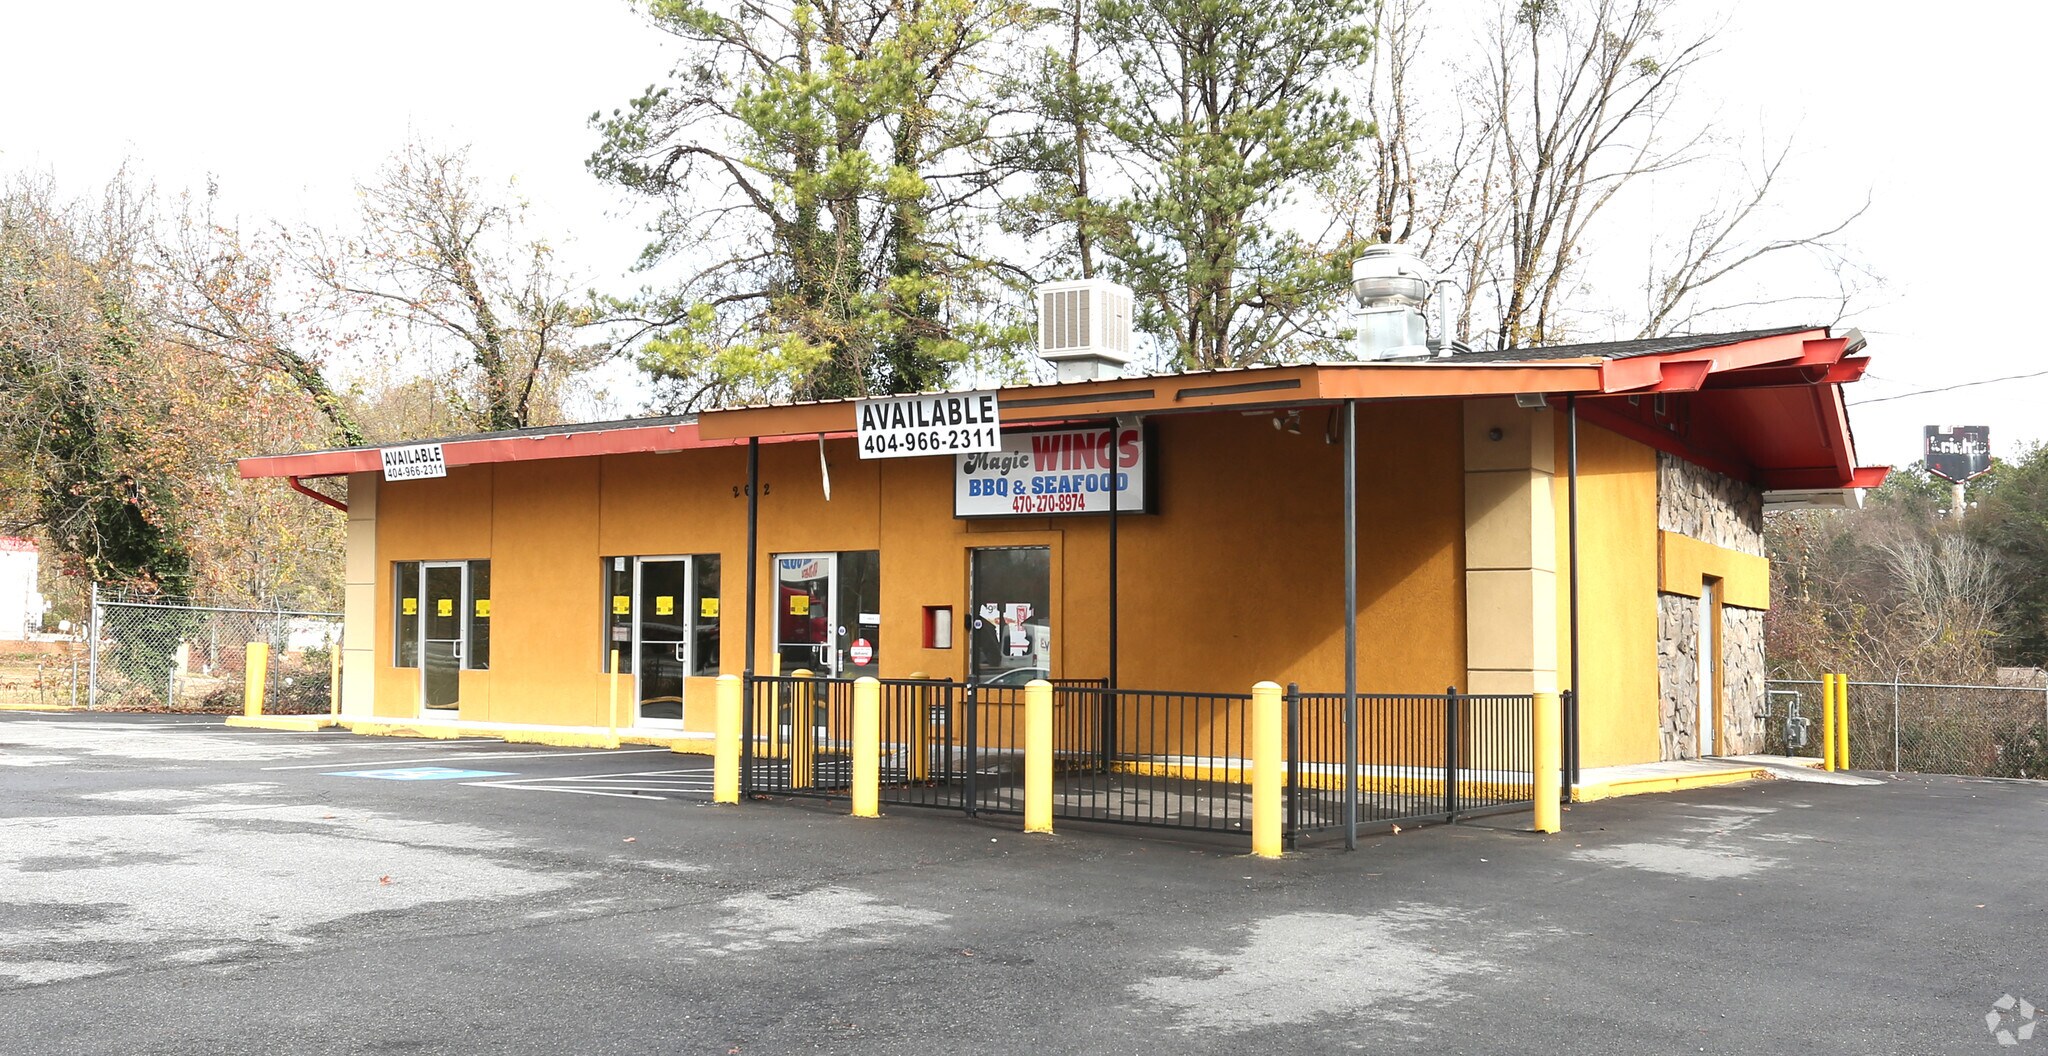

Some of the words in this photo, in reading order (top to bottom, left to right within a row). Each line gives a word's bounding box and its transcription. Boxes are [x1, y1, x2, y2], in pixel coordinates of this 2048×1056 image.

[862, 395, 994, 431] AVAILABLE
[864, 428, 995, 453] 404-966-2311
[963, 451, 1029, 476] Magic
[1031, 429, 1140, 472] WINGS
[385, 447, 441, 466] AVAILABLE
[387, 464, 444, 478] 404-966-2311
[969, 477, 1008, 497] BBQ
[1012, 480, 1026, 495] &
[1031, 473, 1128, 494] SEAFOOD
[1012, 493, 1085, 513] 470-270-8974
